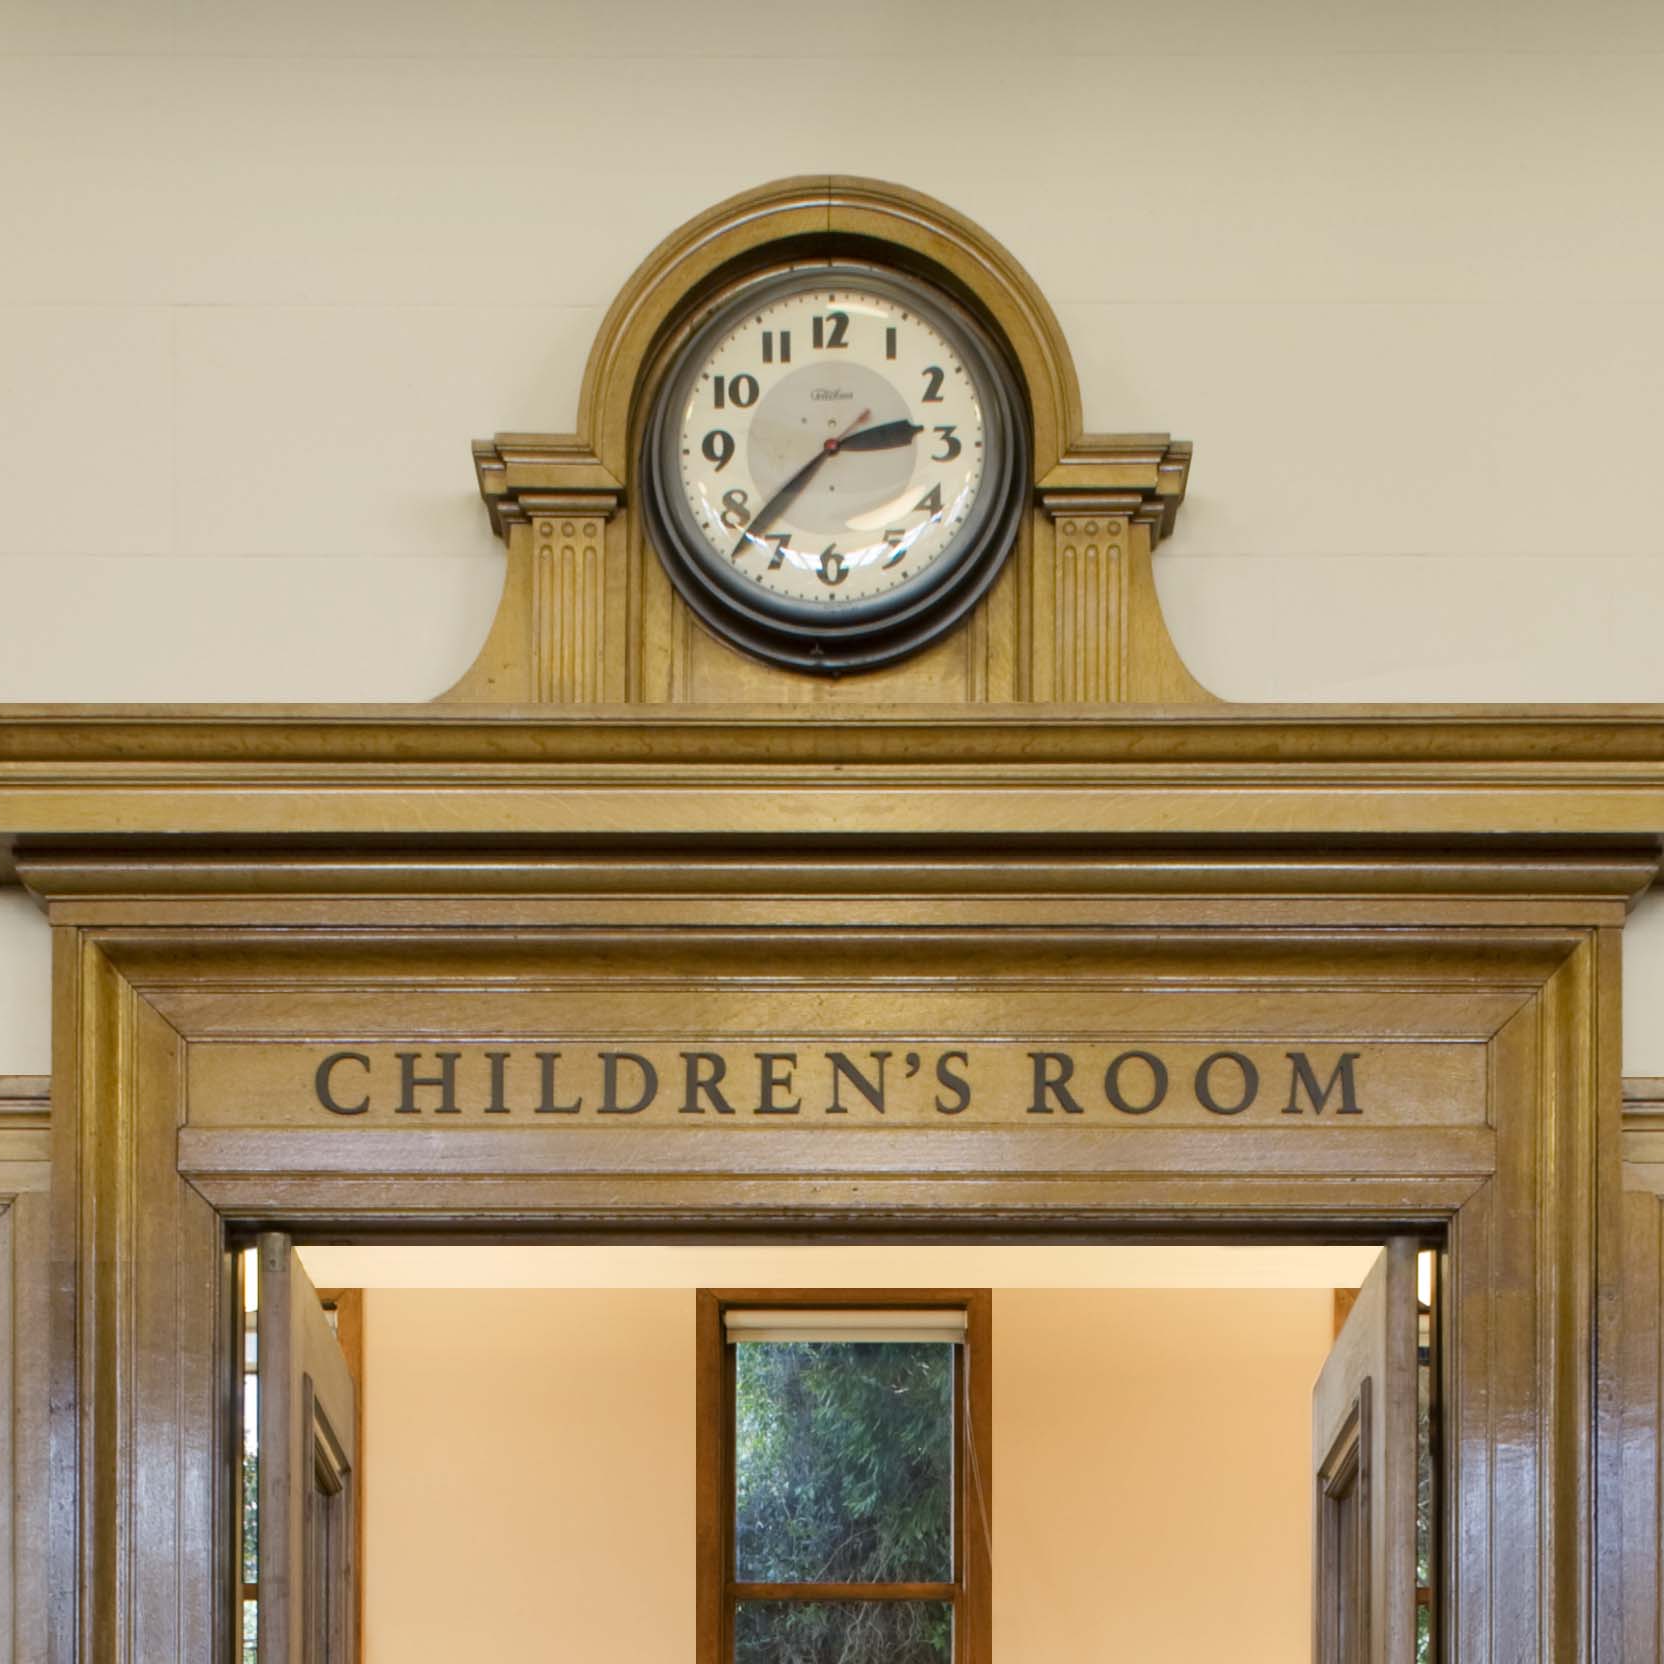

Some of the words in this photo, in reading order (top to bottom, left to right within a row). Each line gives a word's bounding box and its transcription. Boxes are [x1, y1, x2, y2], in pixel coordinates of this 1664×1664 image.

[762, 331, 791, 363] 11
[812, 311, 849, 349] 12
[886, 327, 897, 360] 1
[714, 373, 760, 409] 10
[921, 366, 945, 402] 2
[701, 429, 735, 473] 9
[930, 425, 962, 462] 3
[720, 489, 751, 529] 8
[912, 482, 943, 523] 4
[764, 534, 792, 570] 7
[816, 543, 850, 586] 6
[881, 529, 907, 570] 5
[313, 1050, 973, 1117] CHILDREN'S
[1025, 1050, 1364, 1116] ROOM
